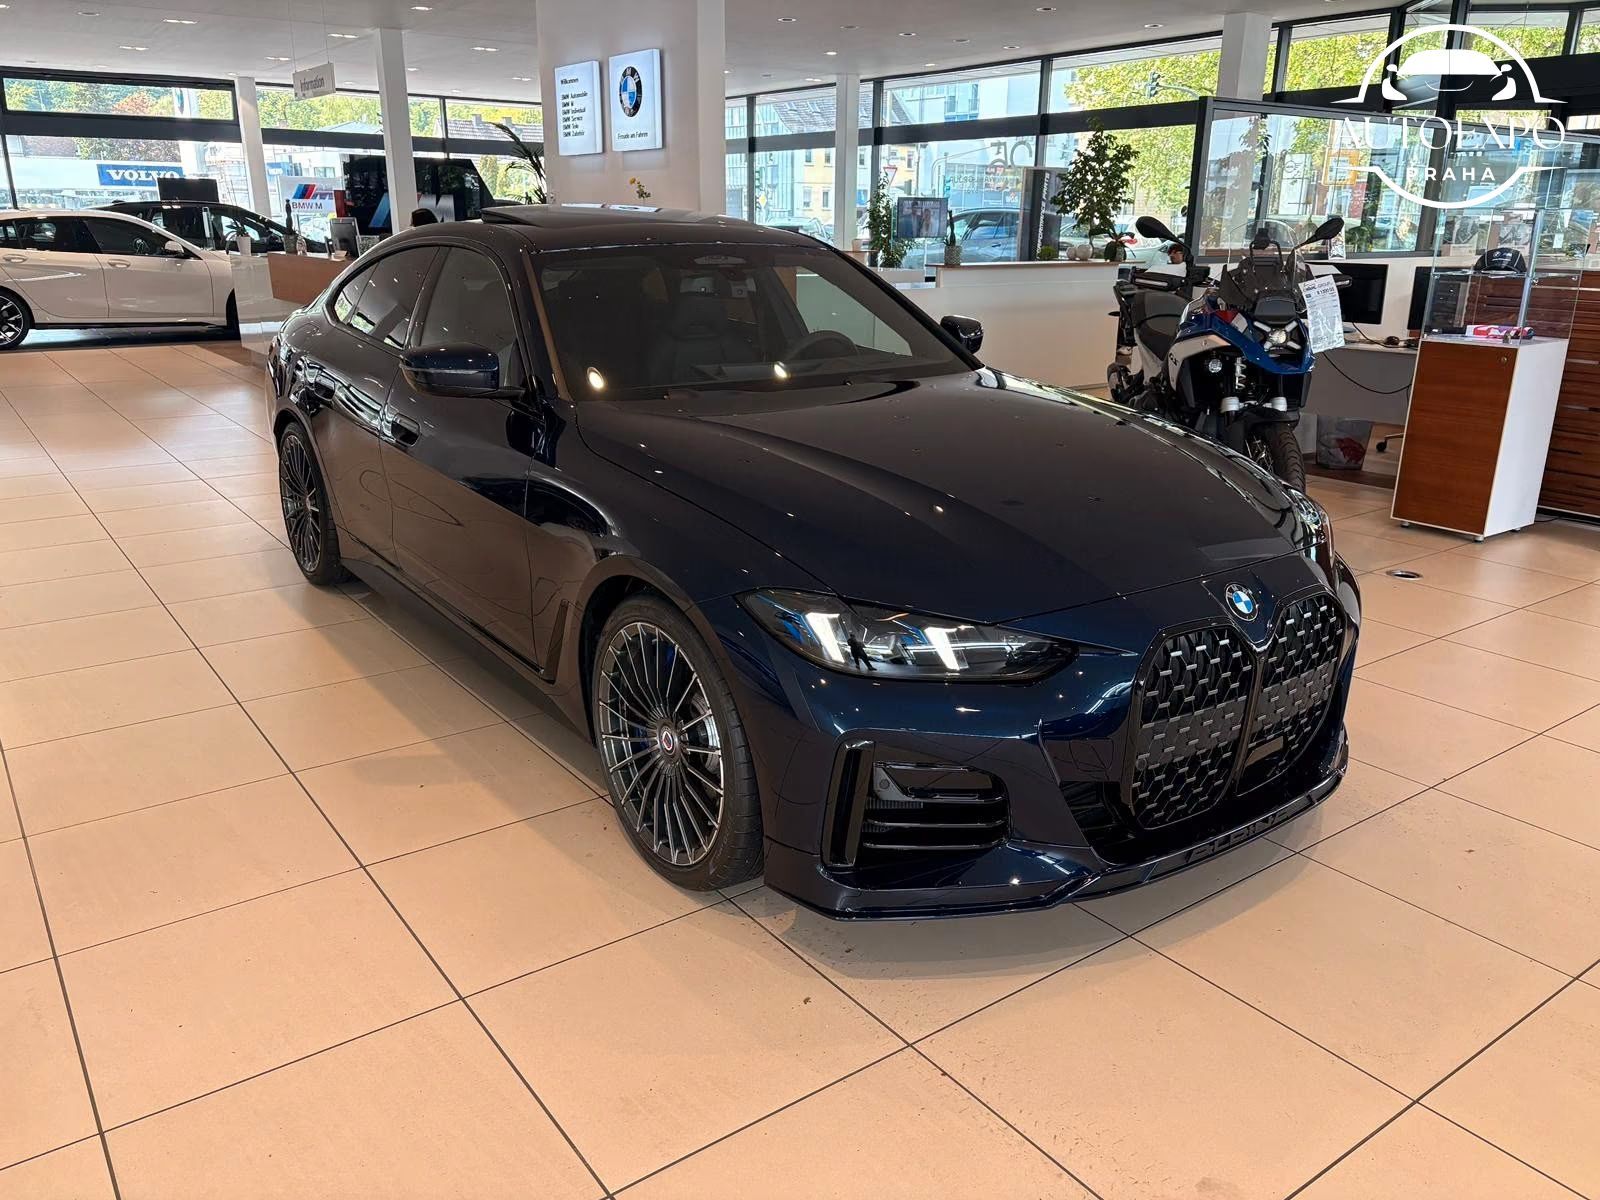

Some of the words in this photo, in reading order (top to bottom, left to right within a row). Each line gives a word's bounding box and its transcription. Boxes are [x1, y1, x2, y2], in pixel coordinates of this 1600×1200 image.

[300, 75, 325, 92] Information
[106, 169, 180, 181] VOLVO
[1042, 171, 1051, 200] PARTS
[292, 202, 314, 210] BMW
[315, 202, 323, 210] M
